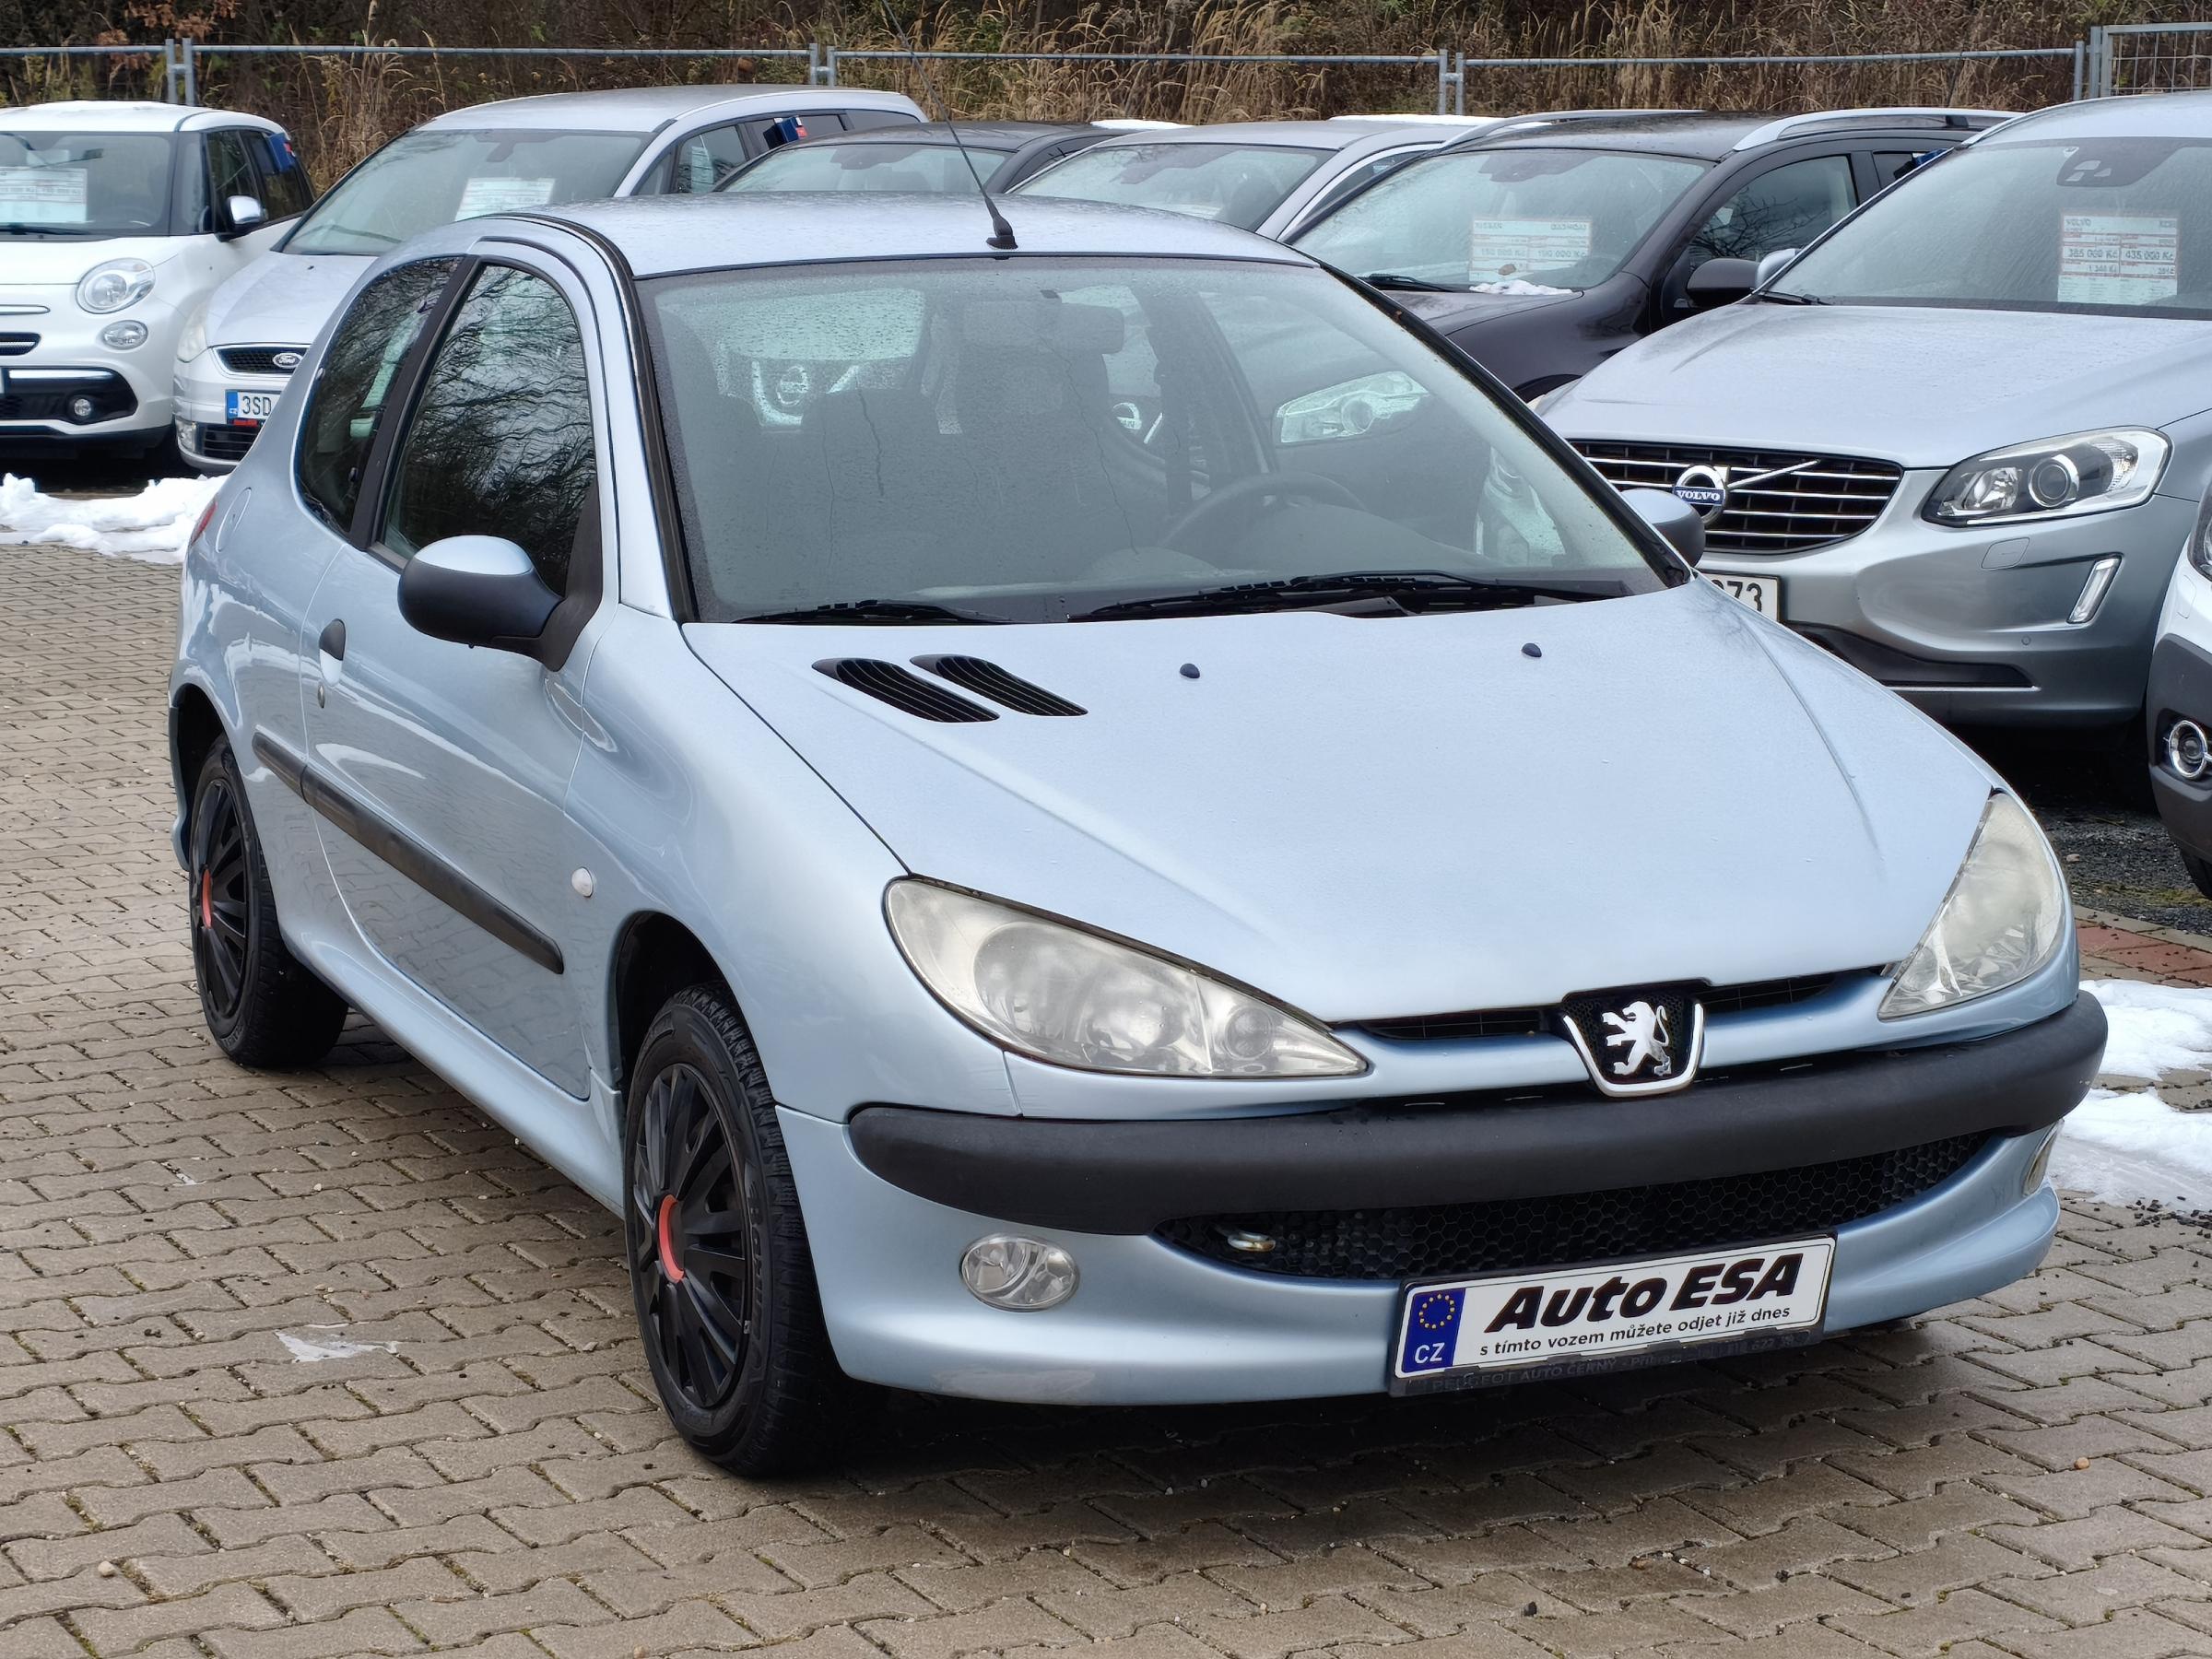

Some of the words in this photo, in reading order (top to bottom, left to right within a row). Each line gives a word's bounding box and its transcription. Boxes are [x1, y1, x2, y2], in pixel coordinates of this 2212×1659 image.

[1676, 489, 1722, 501] VOLVO
[1484, 1276, 1667, 1334] Auto
[1669, 1253, 1804, 1312] ESA
[1480, 1344, 1488, 1357] s
[1494, 1336, 1541, 1355] tímto
[1547, 1331, 1604, 1348] vozem
[1609, 1324, 1672, 1342] můžete
[1677, 1314, 1723, 1335] odjet
[1725, 1309, 1746, 1327] již
[1750, 1305, 1791, 1323] dnes
[1414, 1343, 1445, 1364] CZ
[1519, 1365, 1563, 1381] AUTO
